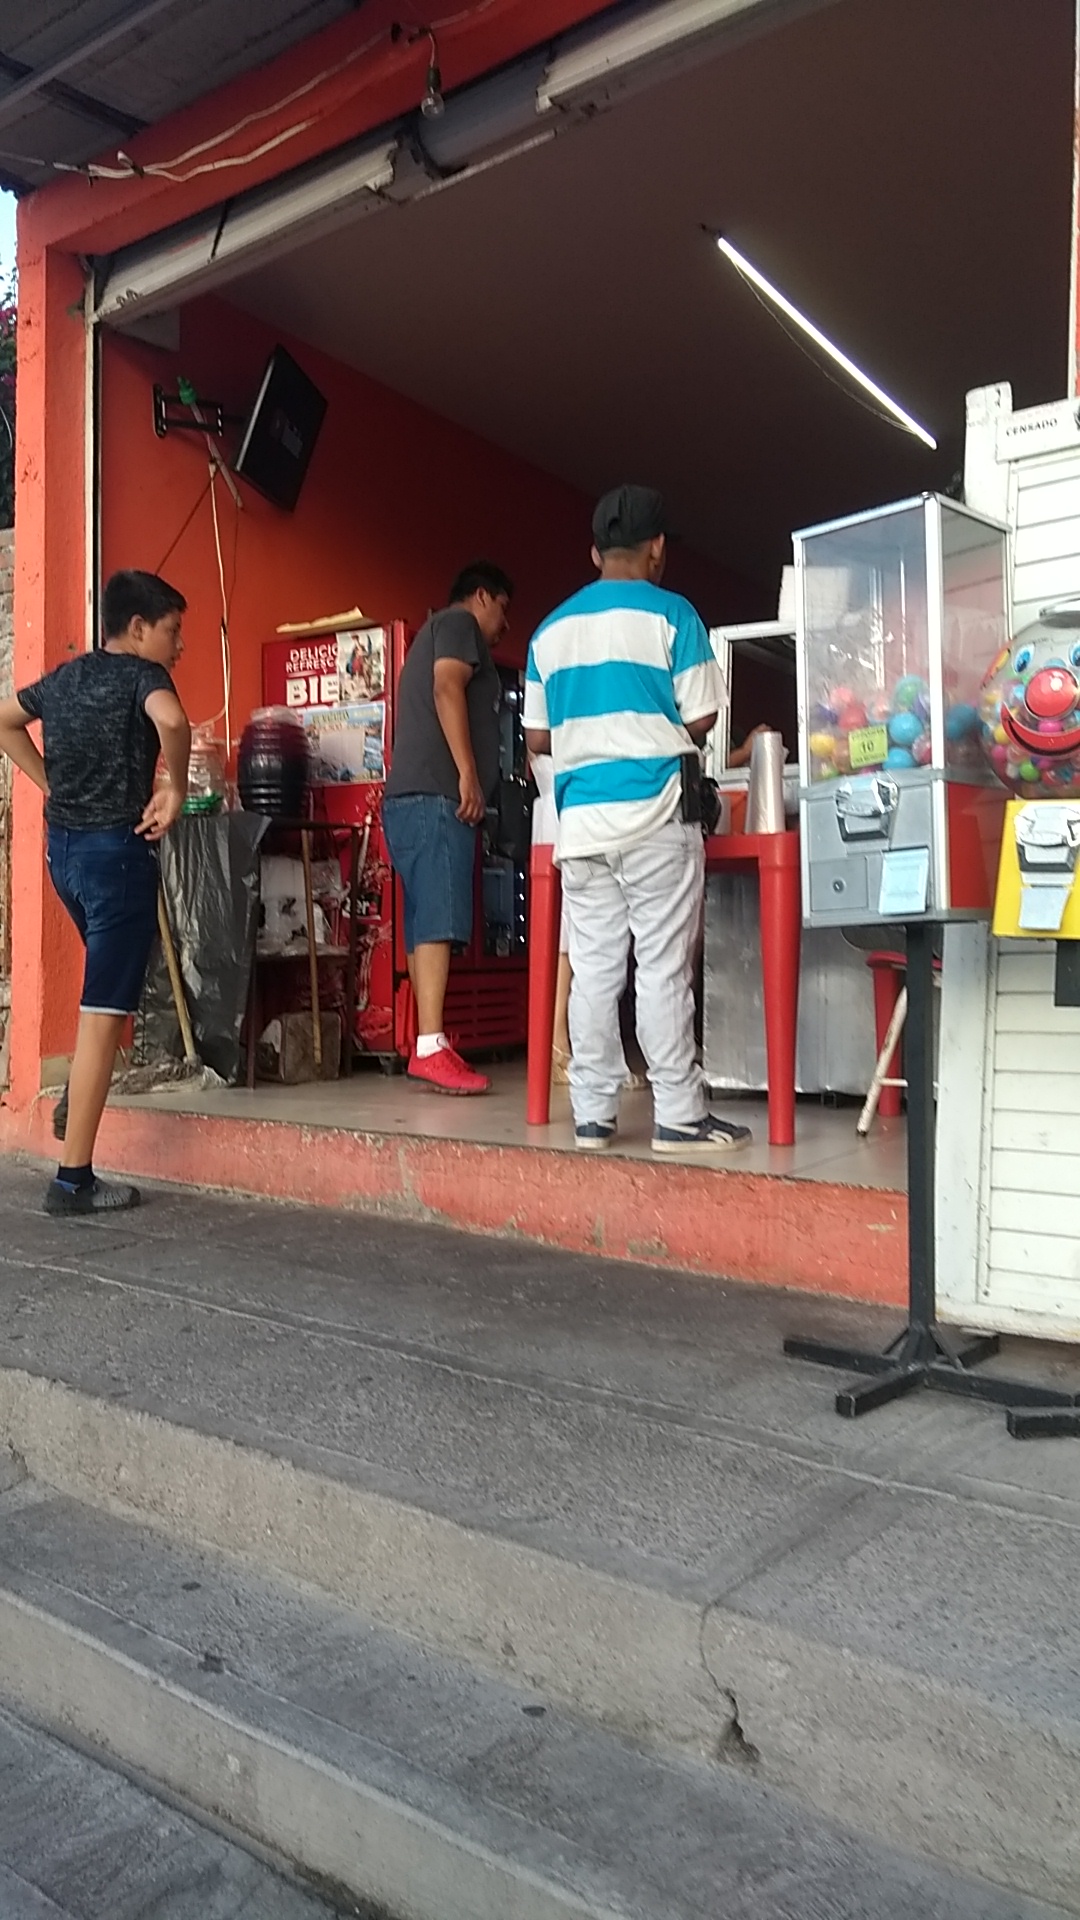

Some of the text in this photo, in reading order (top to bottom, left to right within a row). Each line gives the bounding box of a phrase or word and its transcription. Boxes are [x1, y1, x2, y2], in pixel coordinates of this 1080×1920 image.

[1006, 418, 1058, 437] CENSADO
[286, 655, 338, 673] REFRESC
[286, 674, 339, 707] BIE
[862, 740, 875, 753] 10
